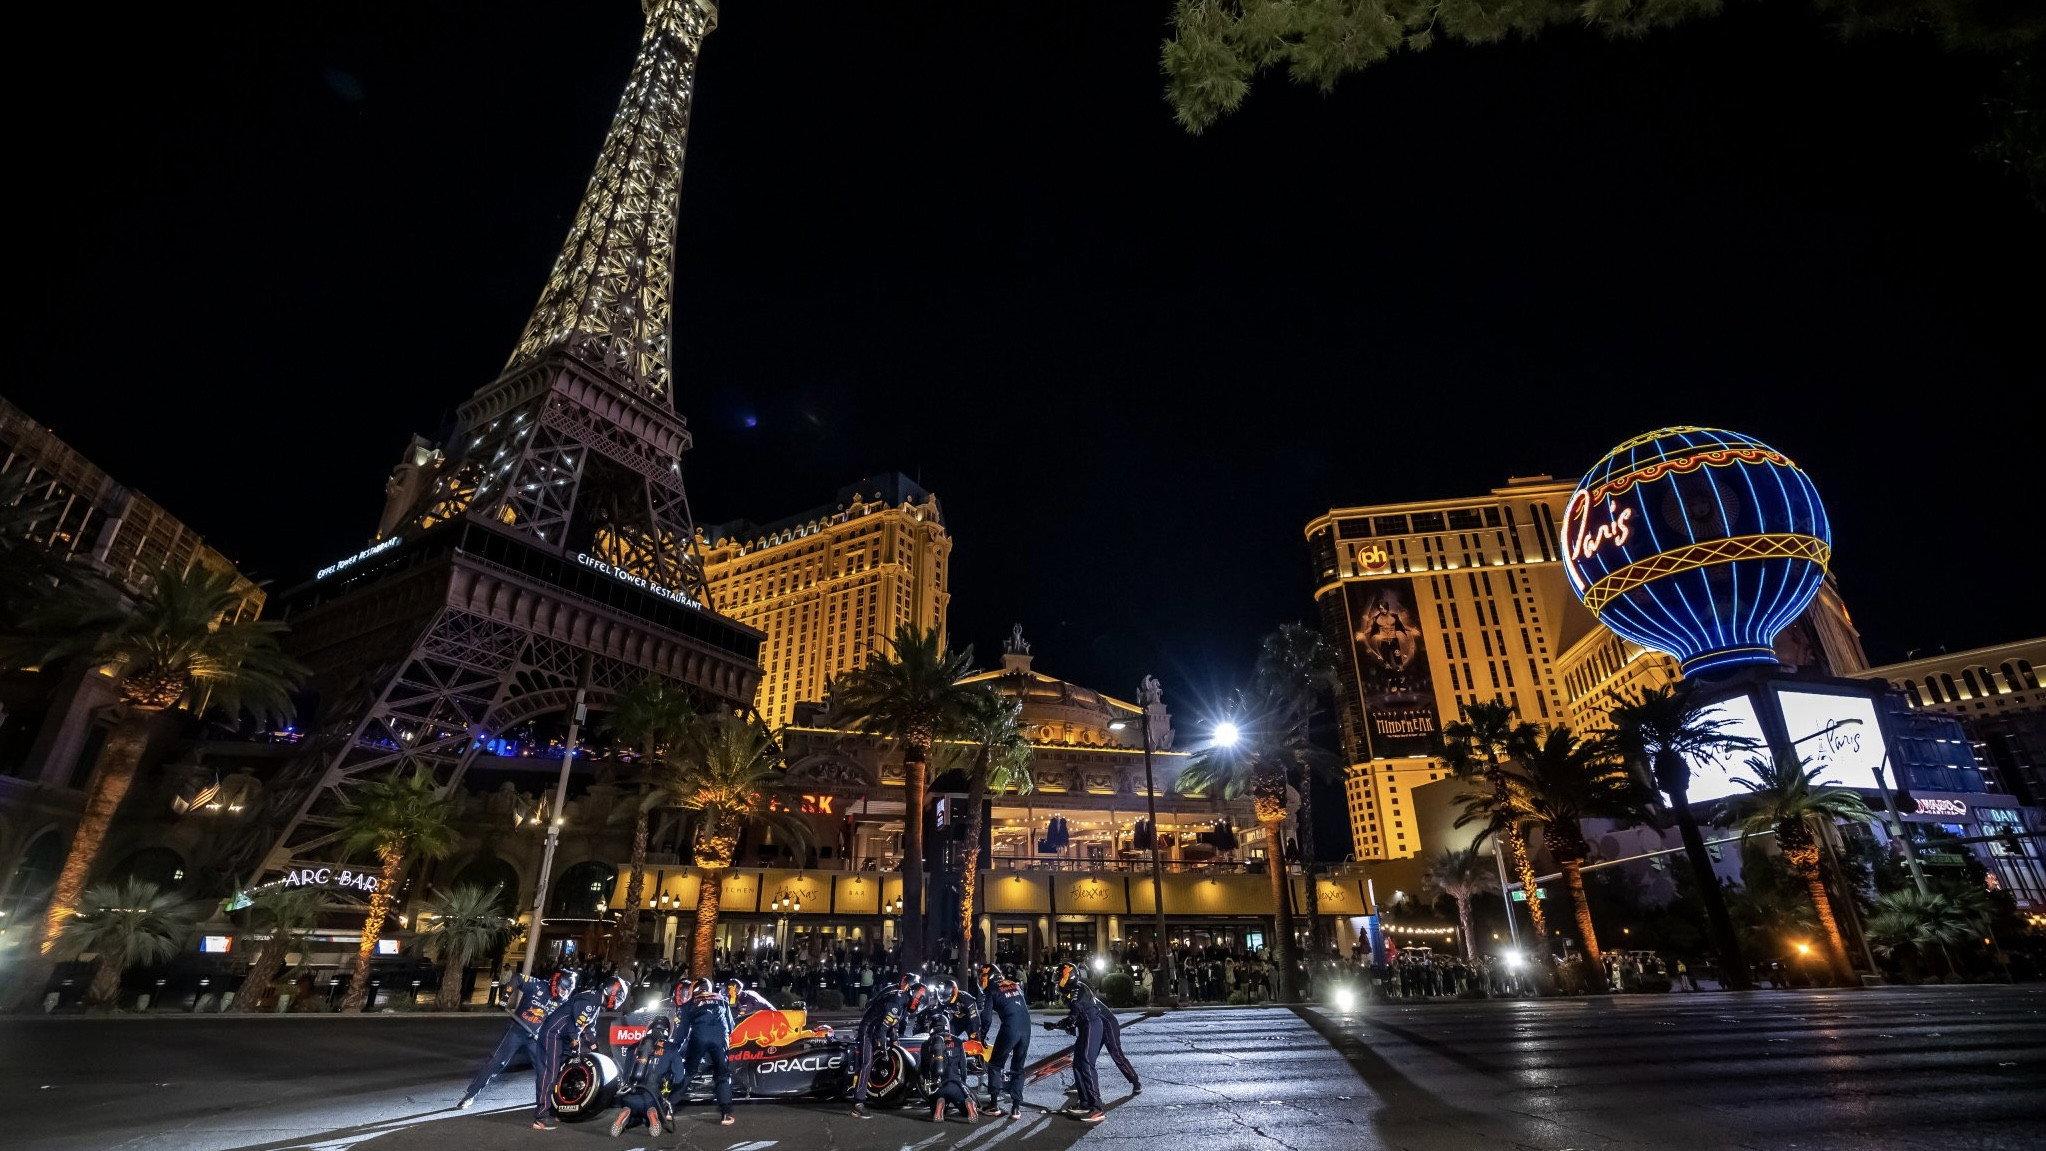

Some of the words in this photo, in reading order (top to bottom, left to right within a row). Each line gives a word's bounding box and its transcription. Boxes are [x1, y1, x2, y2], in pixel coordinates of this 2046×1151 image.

[1561, 489, 1632, 590] Paris
[1362, 546, 1387, 567] ph
[577, 553, 610, 575] EIFFEL
[613, 566, 646, 588] TOWER
[650, 582, 702, 611] RESTAURANT
[1825, 718, 1860, 753] Paris
[285, 868, 331, 887] ARC
[339, 870, 379, 892] BAR
[728, 1051, 743, 1061] ed
[757, 1056, 842, 1074] ORACLE
